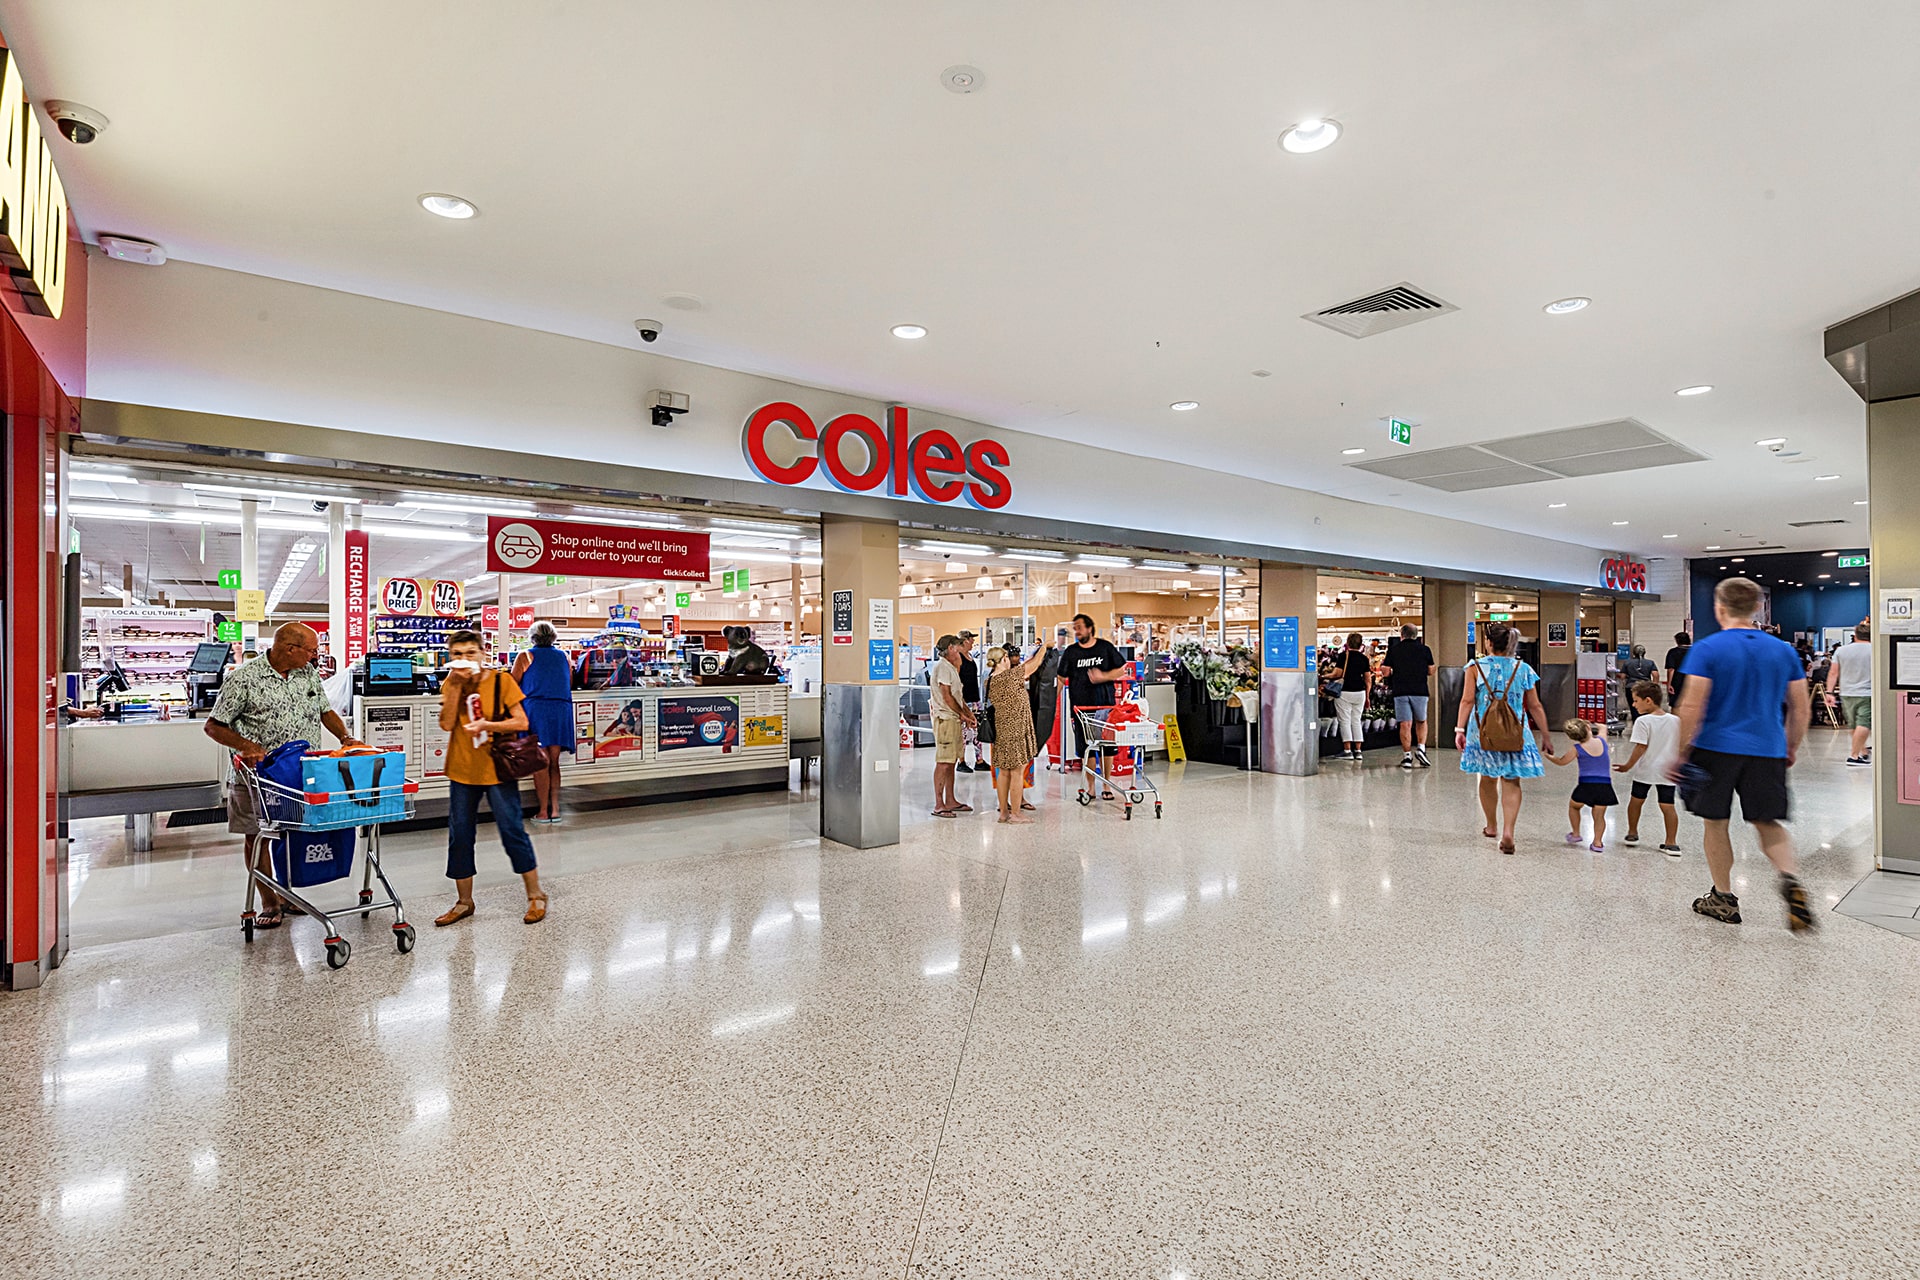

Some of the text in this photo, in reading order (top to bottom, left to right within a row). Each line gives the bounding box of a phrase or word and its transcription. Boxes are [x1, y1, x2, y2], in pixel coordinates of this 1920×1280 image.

[747, 401, 1012, 509] coles
[551, 533, 688, 556] Shop online and we'll bring
[550, 548, 664, 564] your order to your car.
[663, 569, 705, 578] Click&Collect
[1606, 554, 1646, 592] coles
[222, 573, 238, 586] 11
[349, 546, 363, 613] RECHARGE
[390, 581, 415, 599] 1/2
[437, 583, 456, 600] 1/2
[677, 596, 688, 605] 12
[835, 592, 850, 602] OPEN
[388, 599, 417, 609] PRICE
[435, 601, 457, 610] PRICE
[834, 602, 851, 612] 7 DAYS
[1891, 606, 1908, 615] 10
[516, 612, 532, 622] coles
[223, 623, 235, 631] 12
[661, 704, 732, 714] coles Personal Loans
[305, 850, 334, 863] BAG
